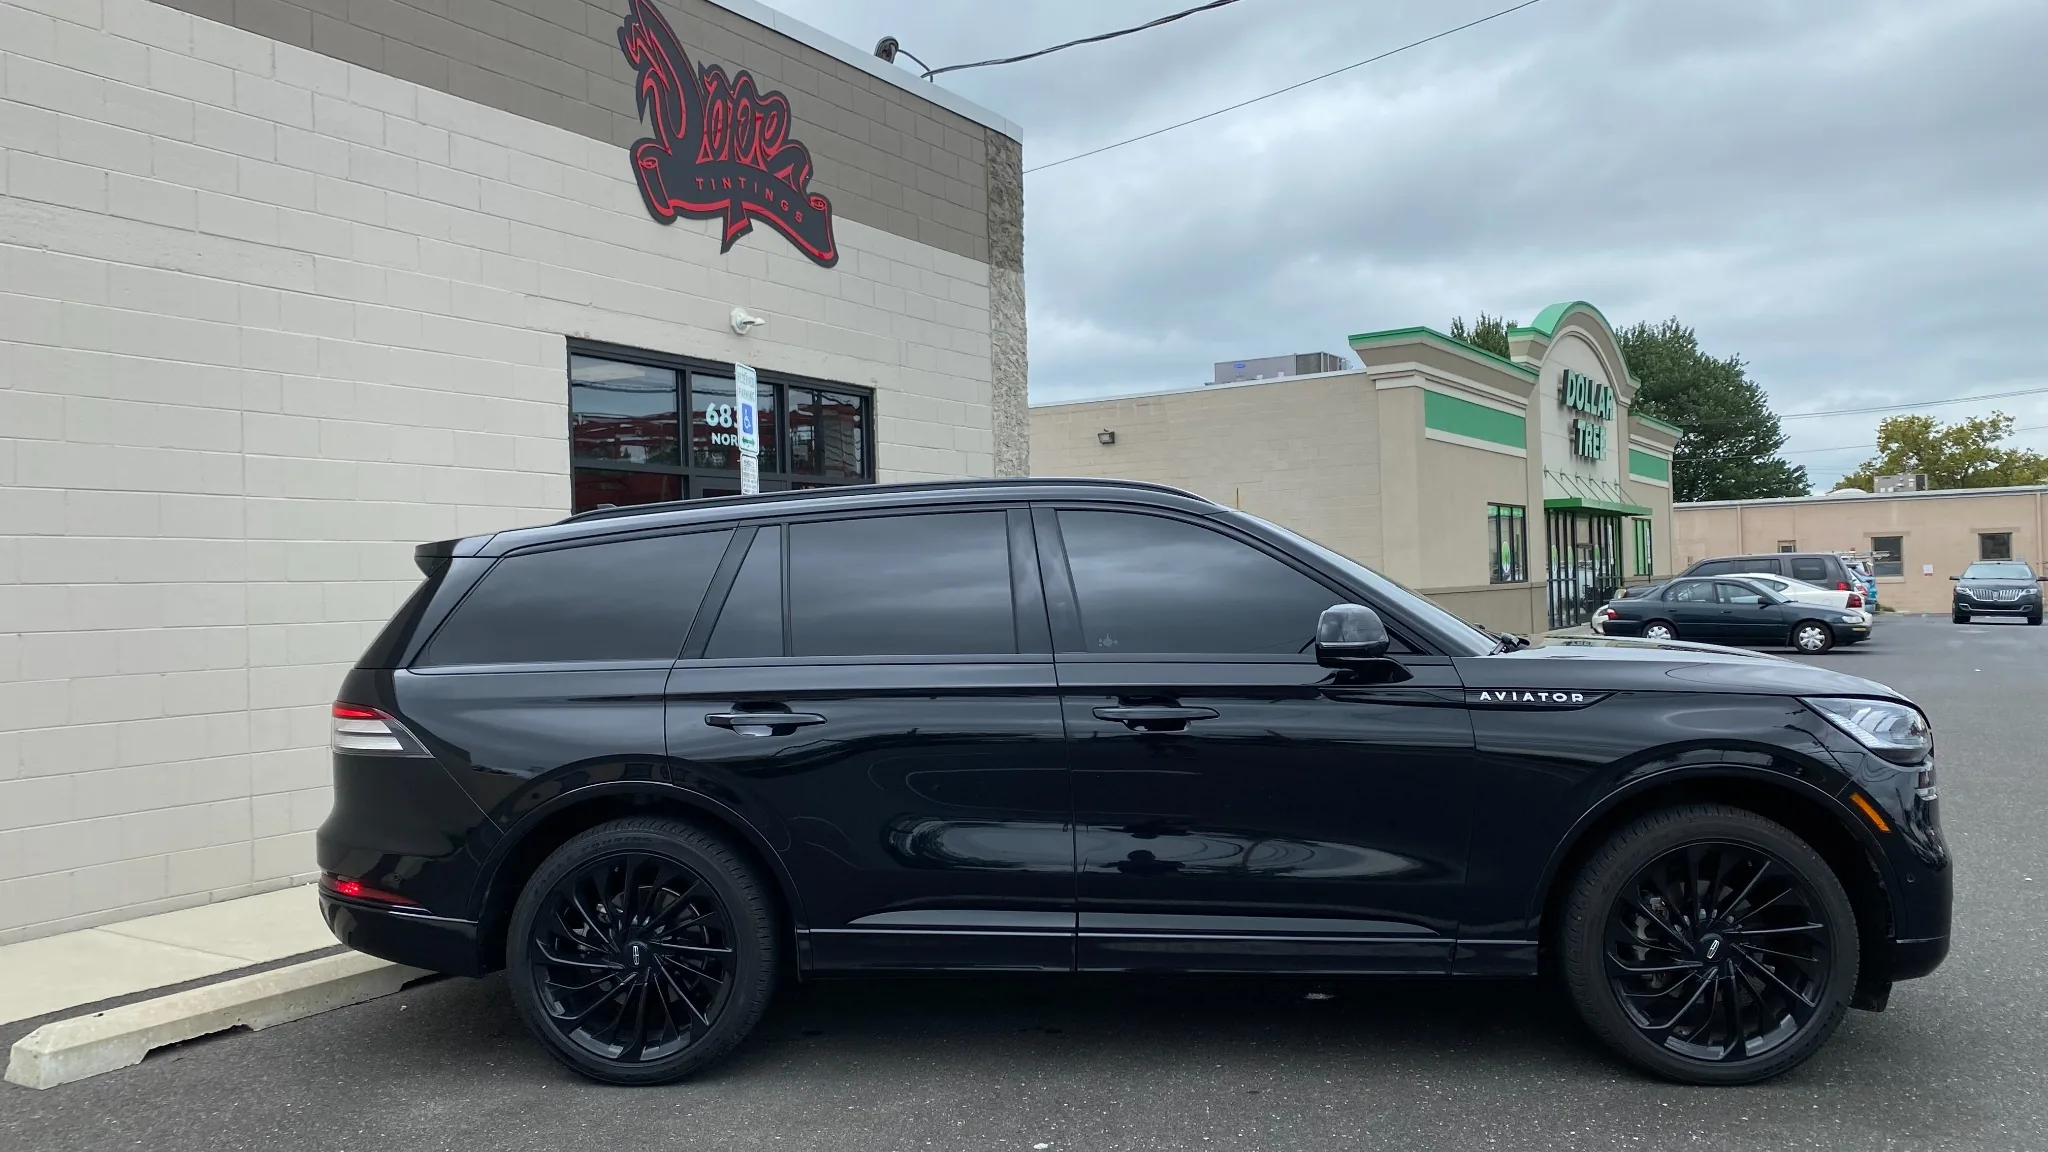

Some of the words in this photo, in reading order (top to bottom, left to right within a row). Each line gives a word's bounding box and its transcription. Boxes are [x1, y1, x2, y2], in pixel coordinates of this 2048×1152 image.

[696, 177, 804, 223] TINTINGS
[705, 402, 738, 429] 68
[1562, 369, 1614, 421] DOLLAR
[1573, 419, 1607, 461] TREE
[1480, 691, 1584, 703] AVIATOR
